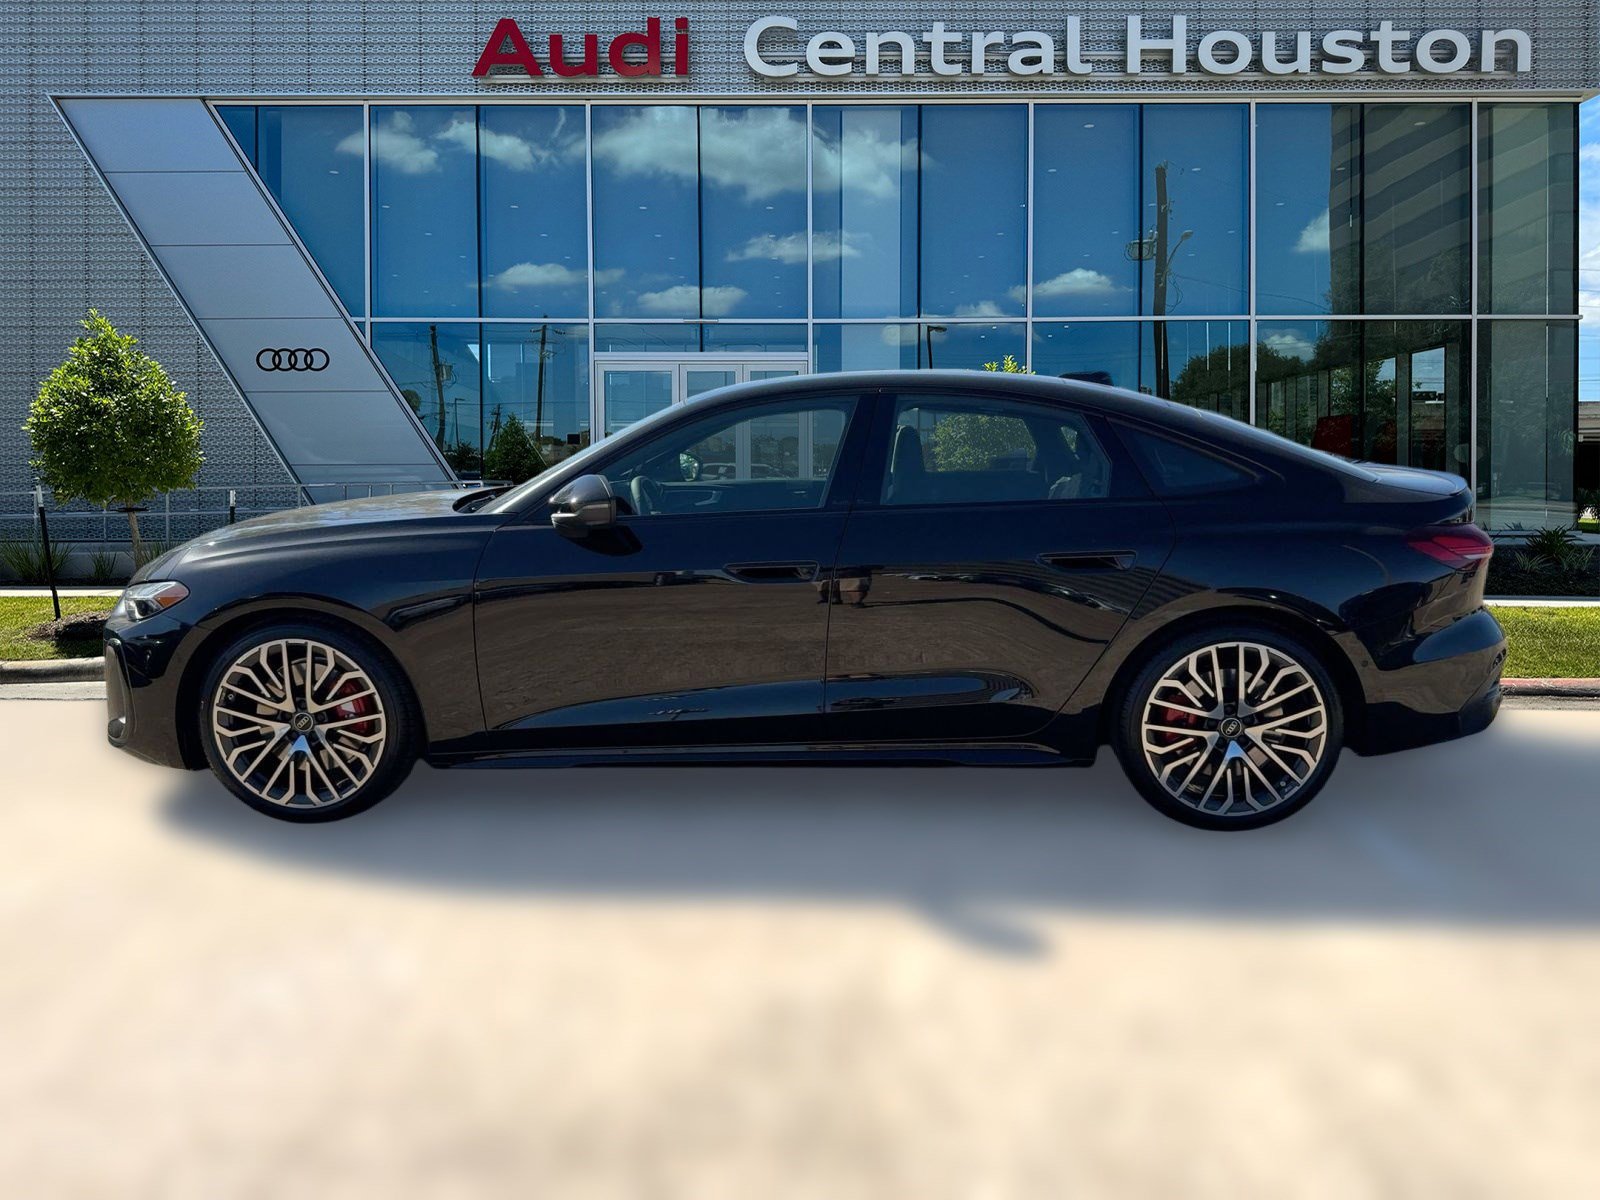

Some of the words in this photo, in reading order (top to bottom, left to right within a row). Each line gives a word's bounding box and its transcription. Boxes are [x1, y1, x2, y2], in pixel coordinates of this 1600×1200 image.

[472, 16, 690, 77] Audi
[743, 15, 1093, 78] Central
[1126, 15, 1532, 76] Houston
